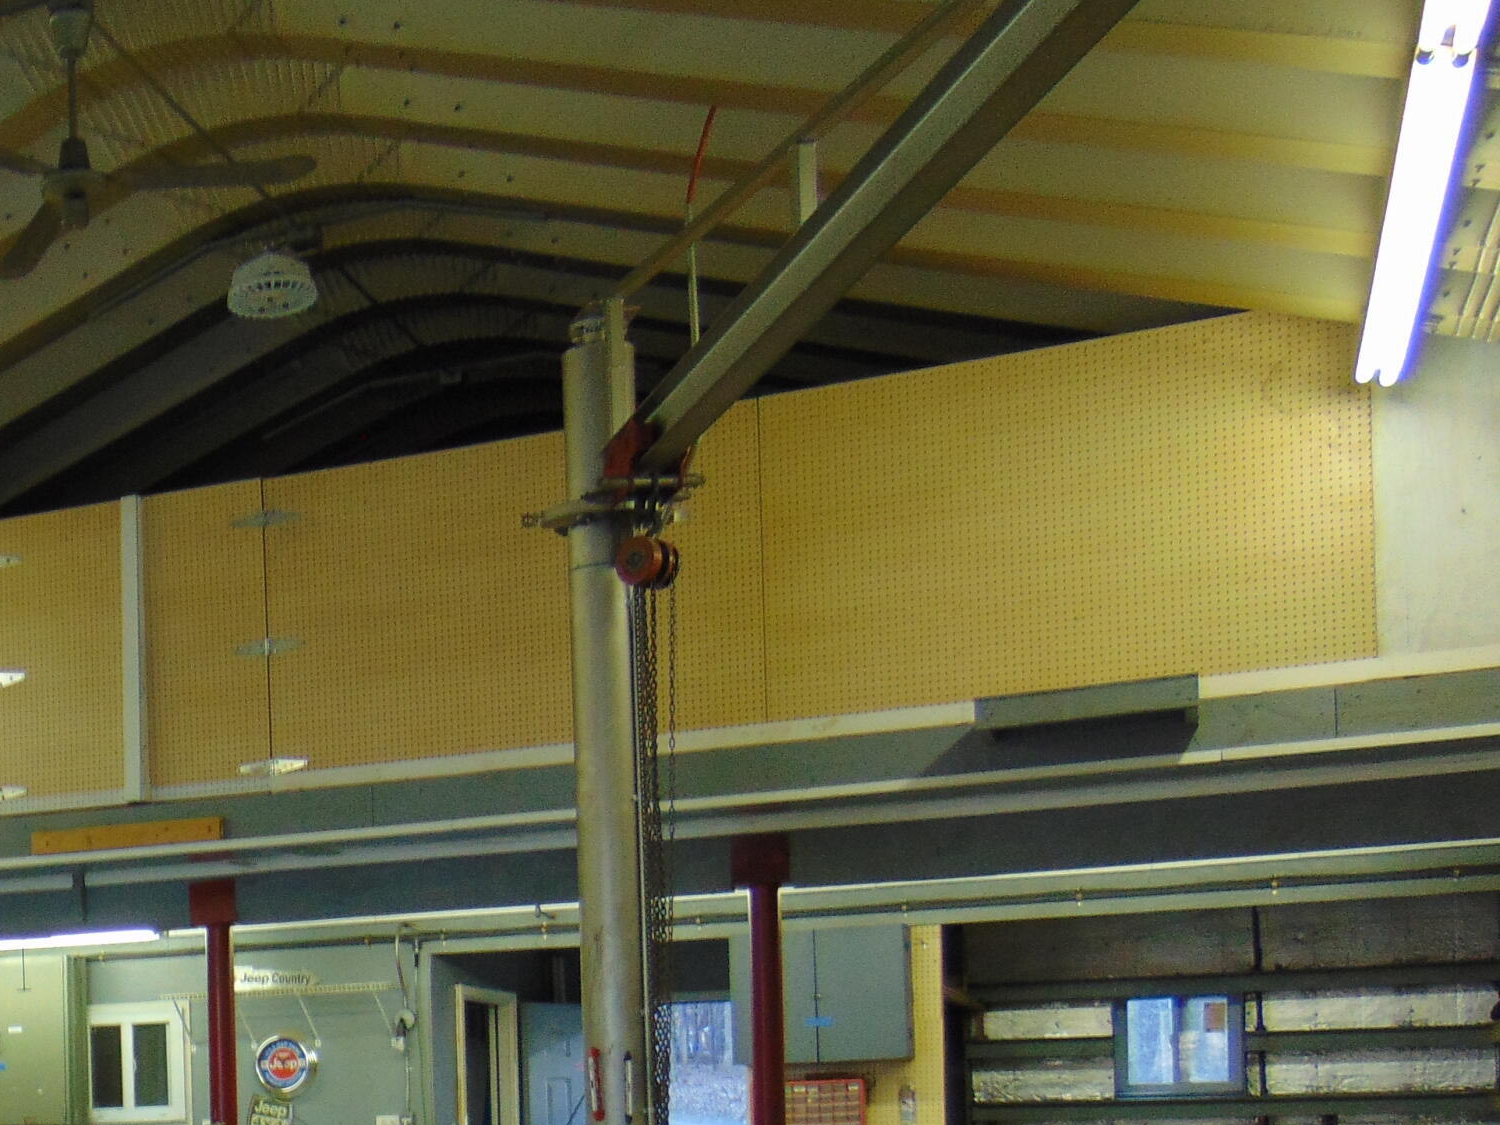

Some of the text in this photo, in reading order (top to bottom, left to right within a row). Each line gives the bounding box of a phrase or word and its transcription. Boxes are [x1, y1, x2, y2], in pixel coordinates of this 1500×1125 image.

[240, 972, 311, 985] Jeep Country
[254, 1100, 288, 1118] Jeep
